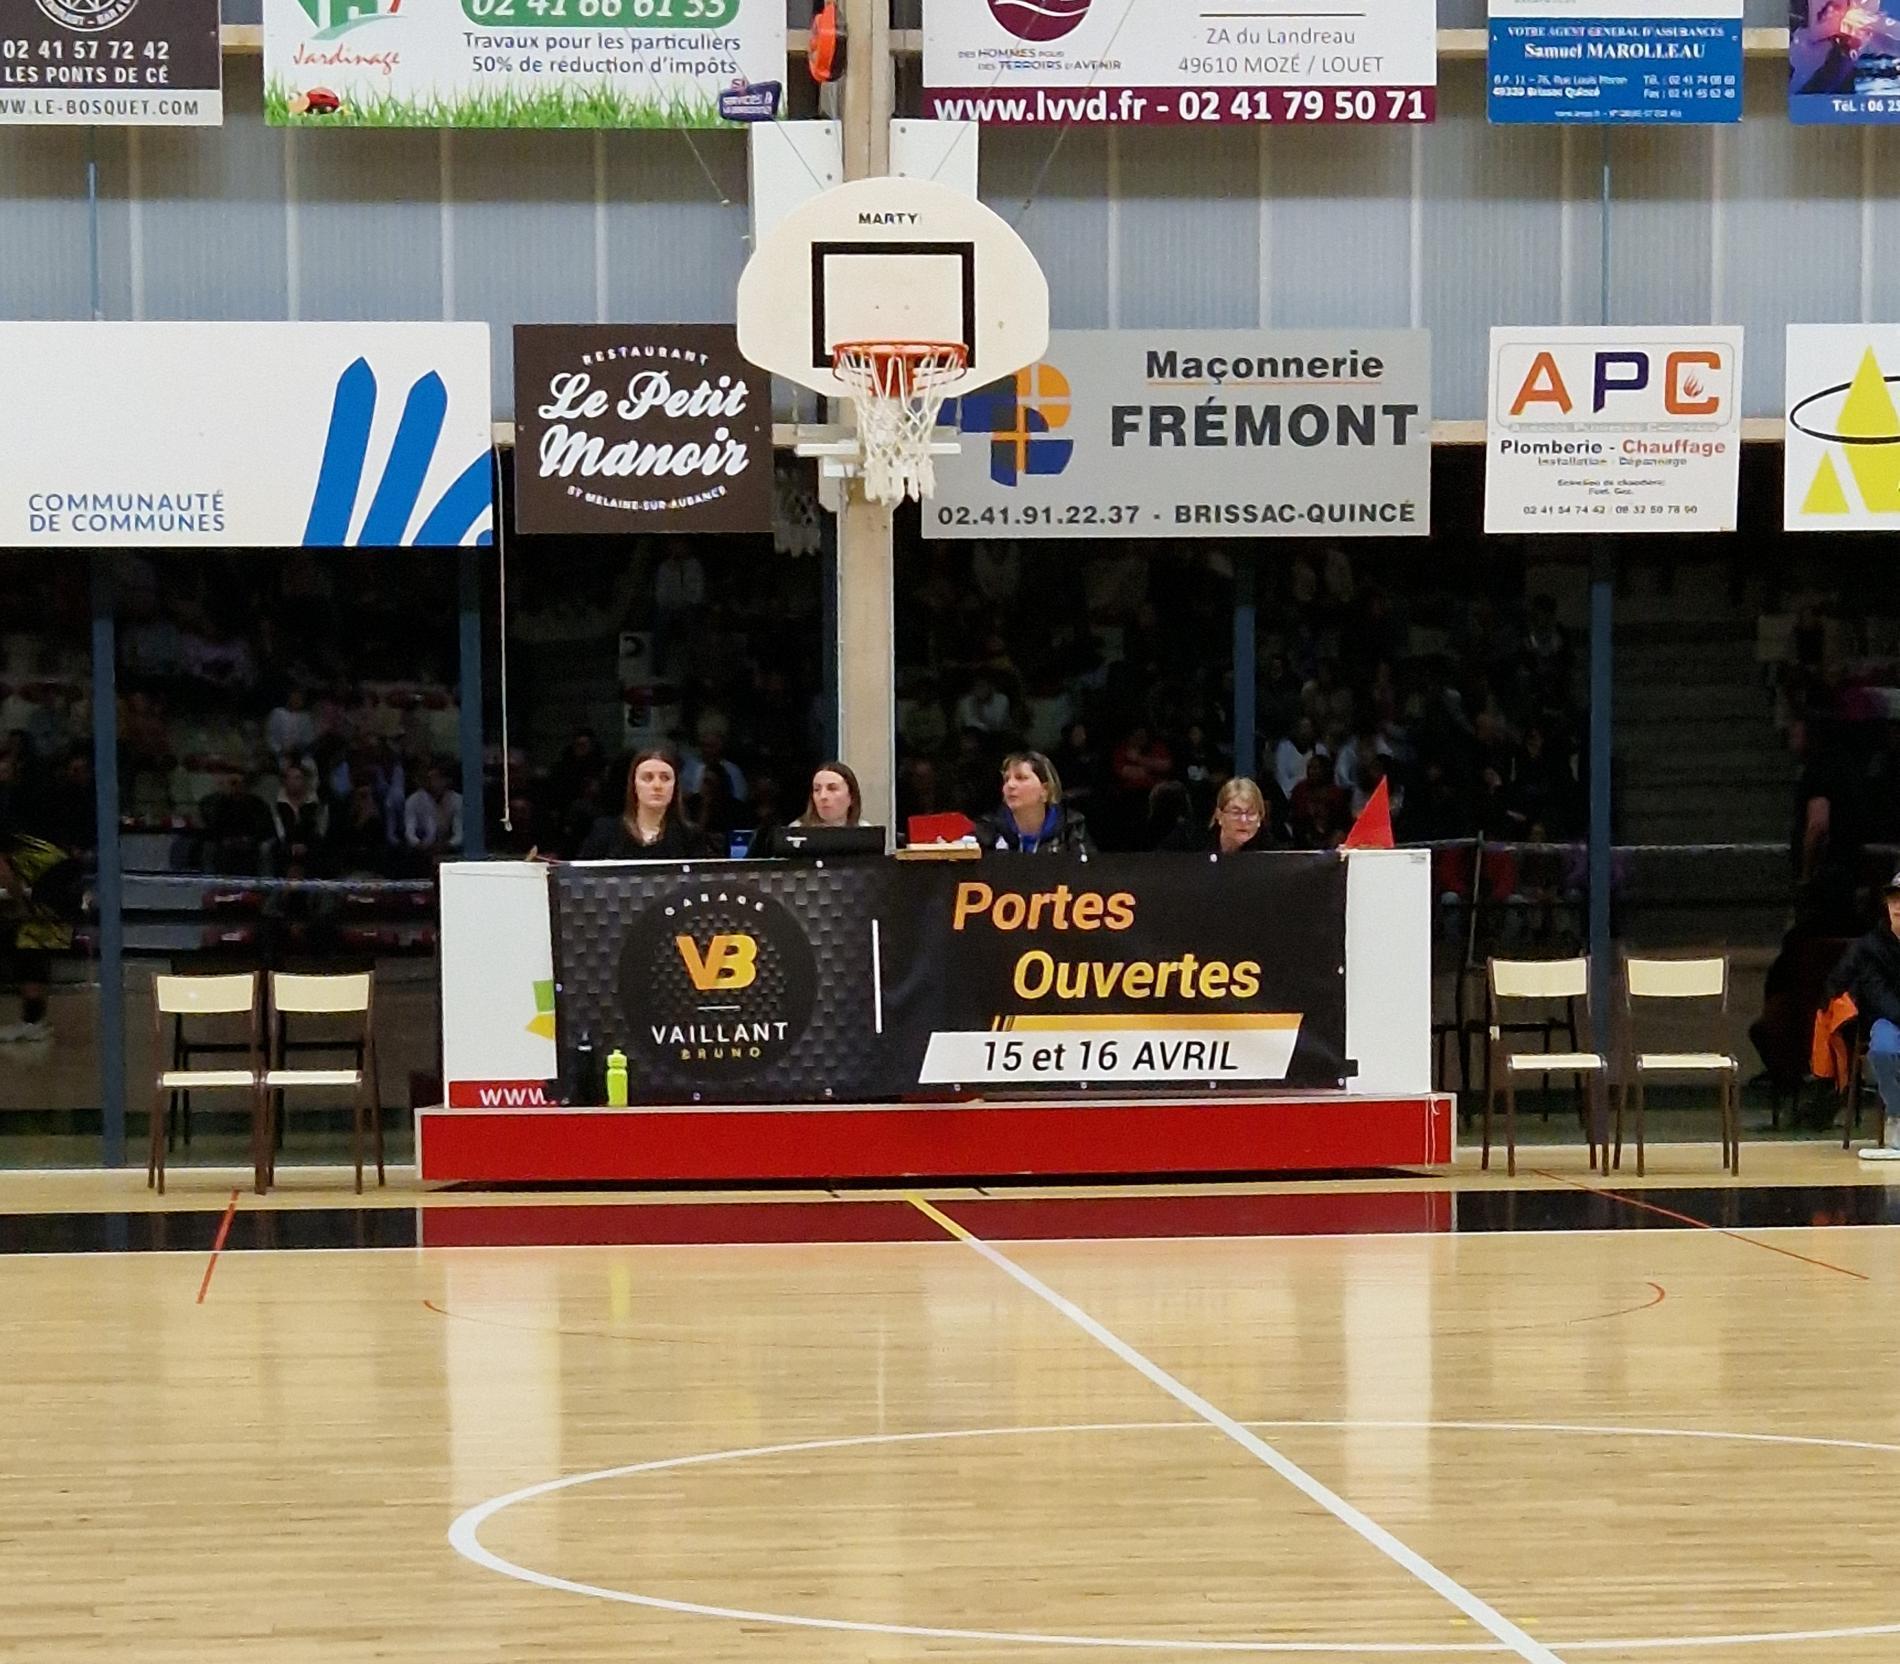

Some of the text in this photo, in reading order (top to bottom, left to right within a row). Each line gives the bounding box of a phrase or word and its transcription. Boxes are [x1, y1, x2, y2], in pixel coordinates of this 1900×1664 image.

[1206, 28, 1355, 45] ZA du Landreau
[1508, 26, 1546, 37] VOTRE
[1548, 26, 1585, 37] AGENT
[3, 40, 170, 60] 02 41 57 72 42
[463, 32, 740, 55] Travaux pour les particuliers
[978, 49, 1036, 58] HOMMES
[1524, 43, 1706, 59] Samuel MAROLLEAU
[293, 43, 400, 75] Jardinage
[472, 56, 737, 77] 50% de réduction d'impôts
[1178, 52, 1384, 75] 49610 MOZÉ / LOUET
[5, 64, 169, 83] LES PONTS DE CÉ
[933, 91, 1147, 122] www.lvvd.fr
[1179, 92, 1221, 120] 02
[1231, 92, 1272, 120] 41
[1283, 92, 1323, 120] 79
[1335, 91, 1376, 119] 50
[1387, 90, 1426, 119] 71
[1867, 99, 1884, 112] 06
[858, 213, 918, 225] MARTY
[582, 346, 709, 366] RESTAURANT
[1147, 350, 1384, 385] Maçonnerie
[538, 370, 750, 421] Le Petit
[1111, 396, 1418, 447] FRÉMONT
[539, 423, 750, 478] Manoir
[1500, 439, 1603, 455] Plomberie
[1622, 439, 1726, 457] Chauffage
[28, 489, 225, 512] COMMUNAUTÉ
[1523, 506, 1536, 515] 02
[1575, 506, 1588, 515] 74
[29, 513, 225, 532] DE COMMUNES
[937, 505, 1140, 526] 02.41.91.22.37
[1175, 500, 1416, 525] BRISSAC-QUINCÉ
[664, 892, 764, 916] GARAGE
[953, 881, 1136, 931] Portes
[675, 934, 757, 990] VB
[1013, 950, 1261, 999] Ouvertes
[651, 1021, 788, 1045] VAILLANT
[681, 1046, 761, 1060] BRUNO
[984, 1040, 1239, 1071] 15 et 16 AVRIL
